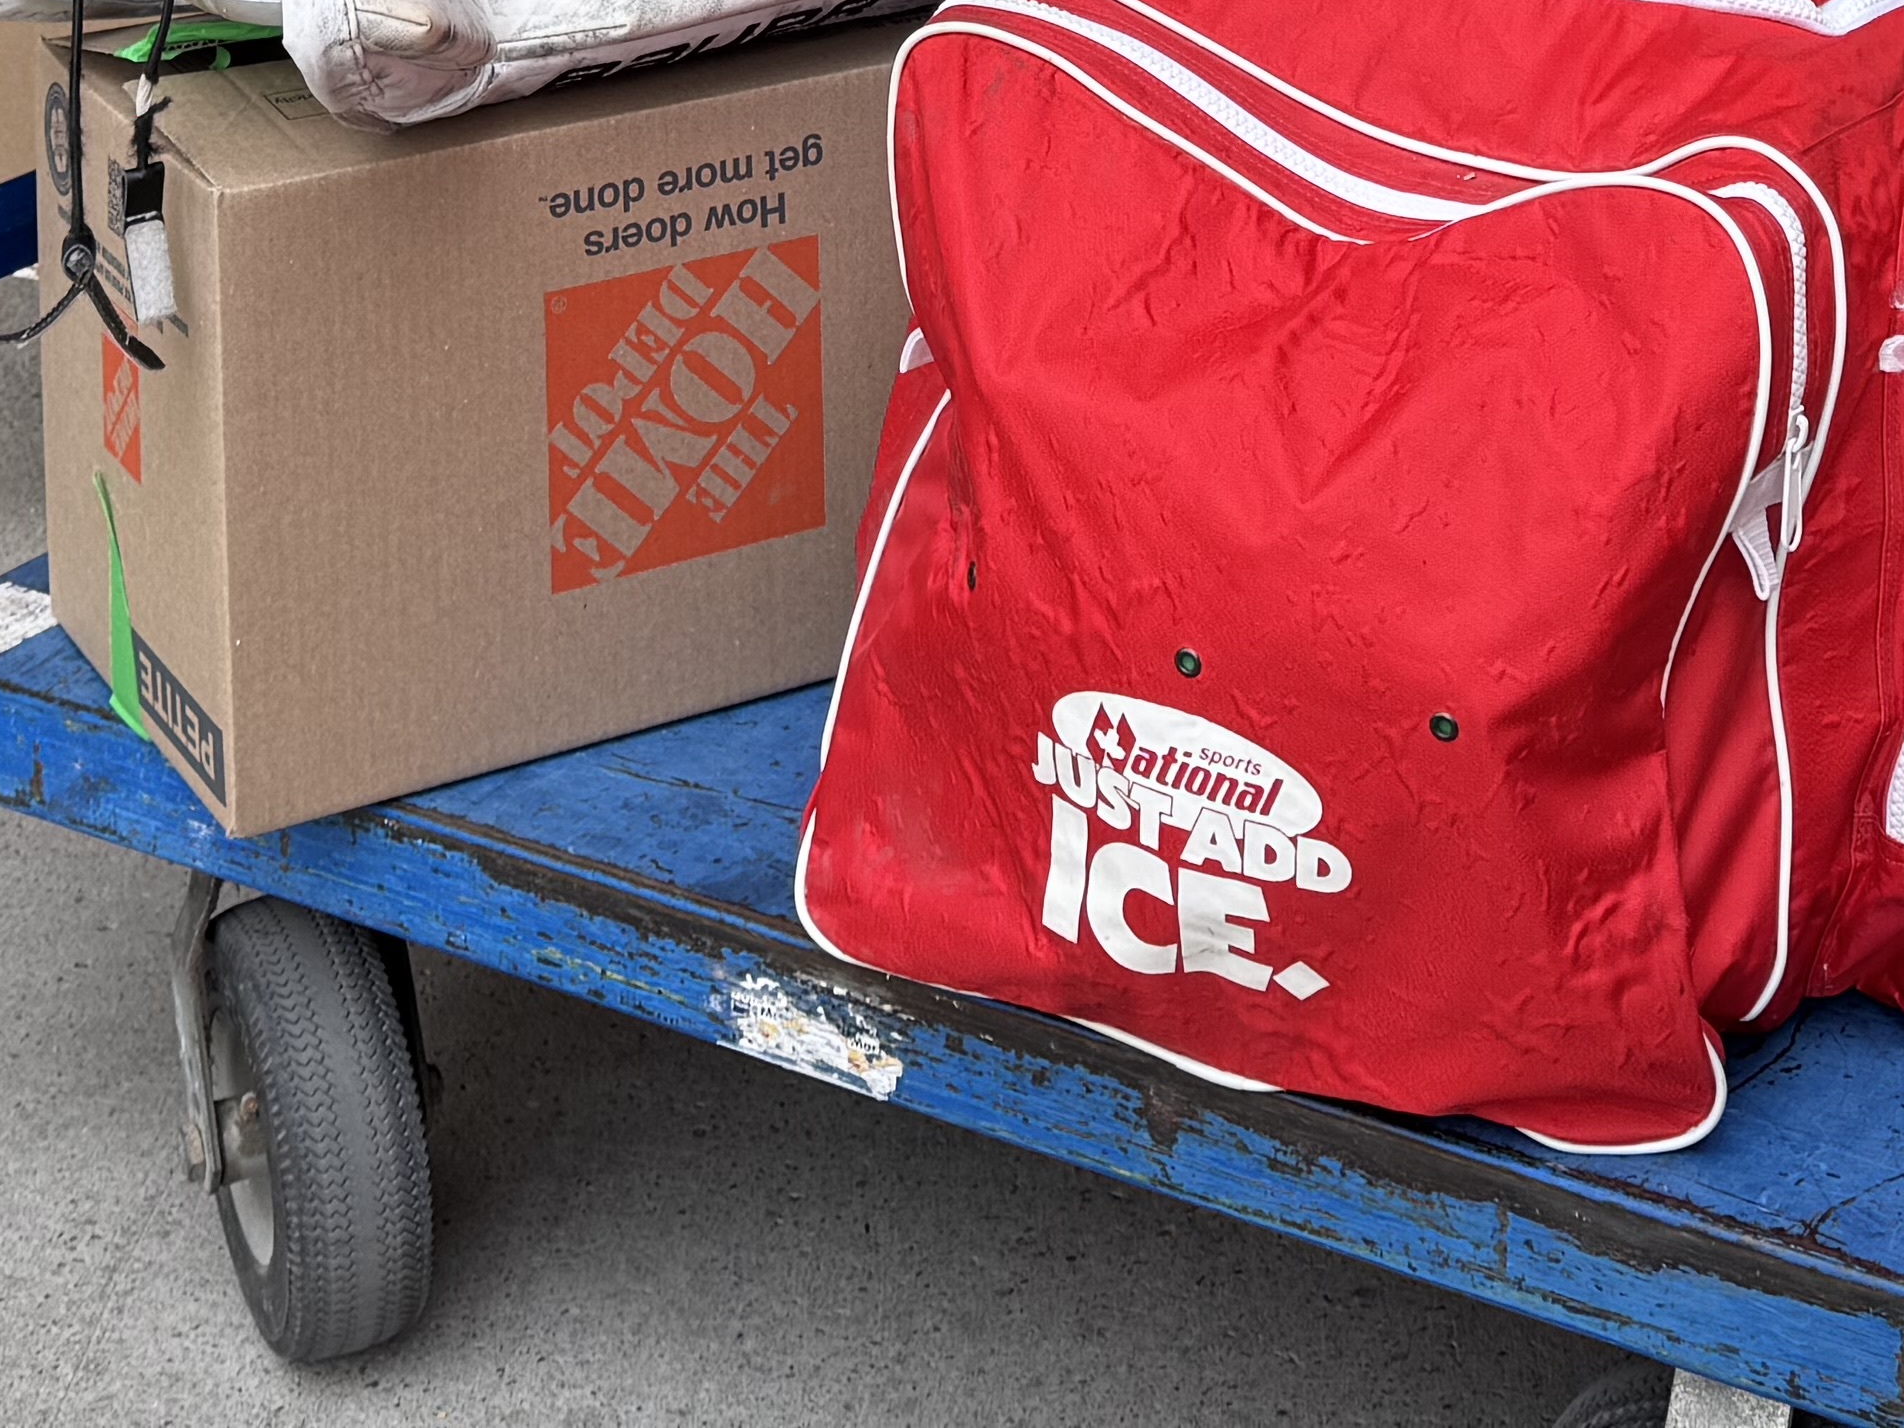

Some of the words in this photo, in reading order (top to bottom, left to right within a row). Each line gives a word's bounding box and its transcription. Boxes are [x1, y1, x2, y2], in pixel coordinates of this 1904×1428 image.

[657, 154, 753, 198] more
[764, 134, 824, 182] get
[548, 175, 645, 219] done.
[704, 192, 787, 232] How
[584, 214, 692, 257] doers
[548, 263, 714, 479] DEPOT
[549, 246, 819, 585] HOME
[685, 392, 799, 524] THE
[139, 651, 216, 781] PETITE
[1199, 745, 1262, 777] sports
[1032, 731, 1173, 851] JUST
[1180, 807, 1353, 894] ADD
